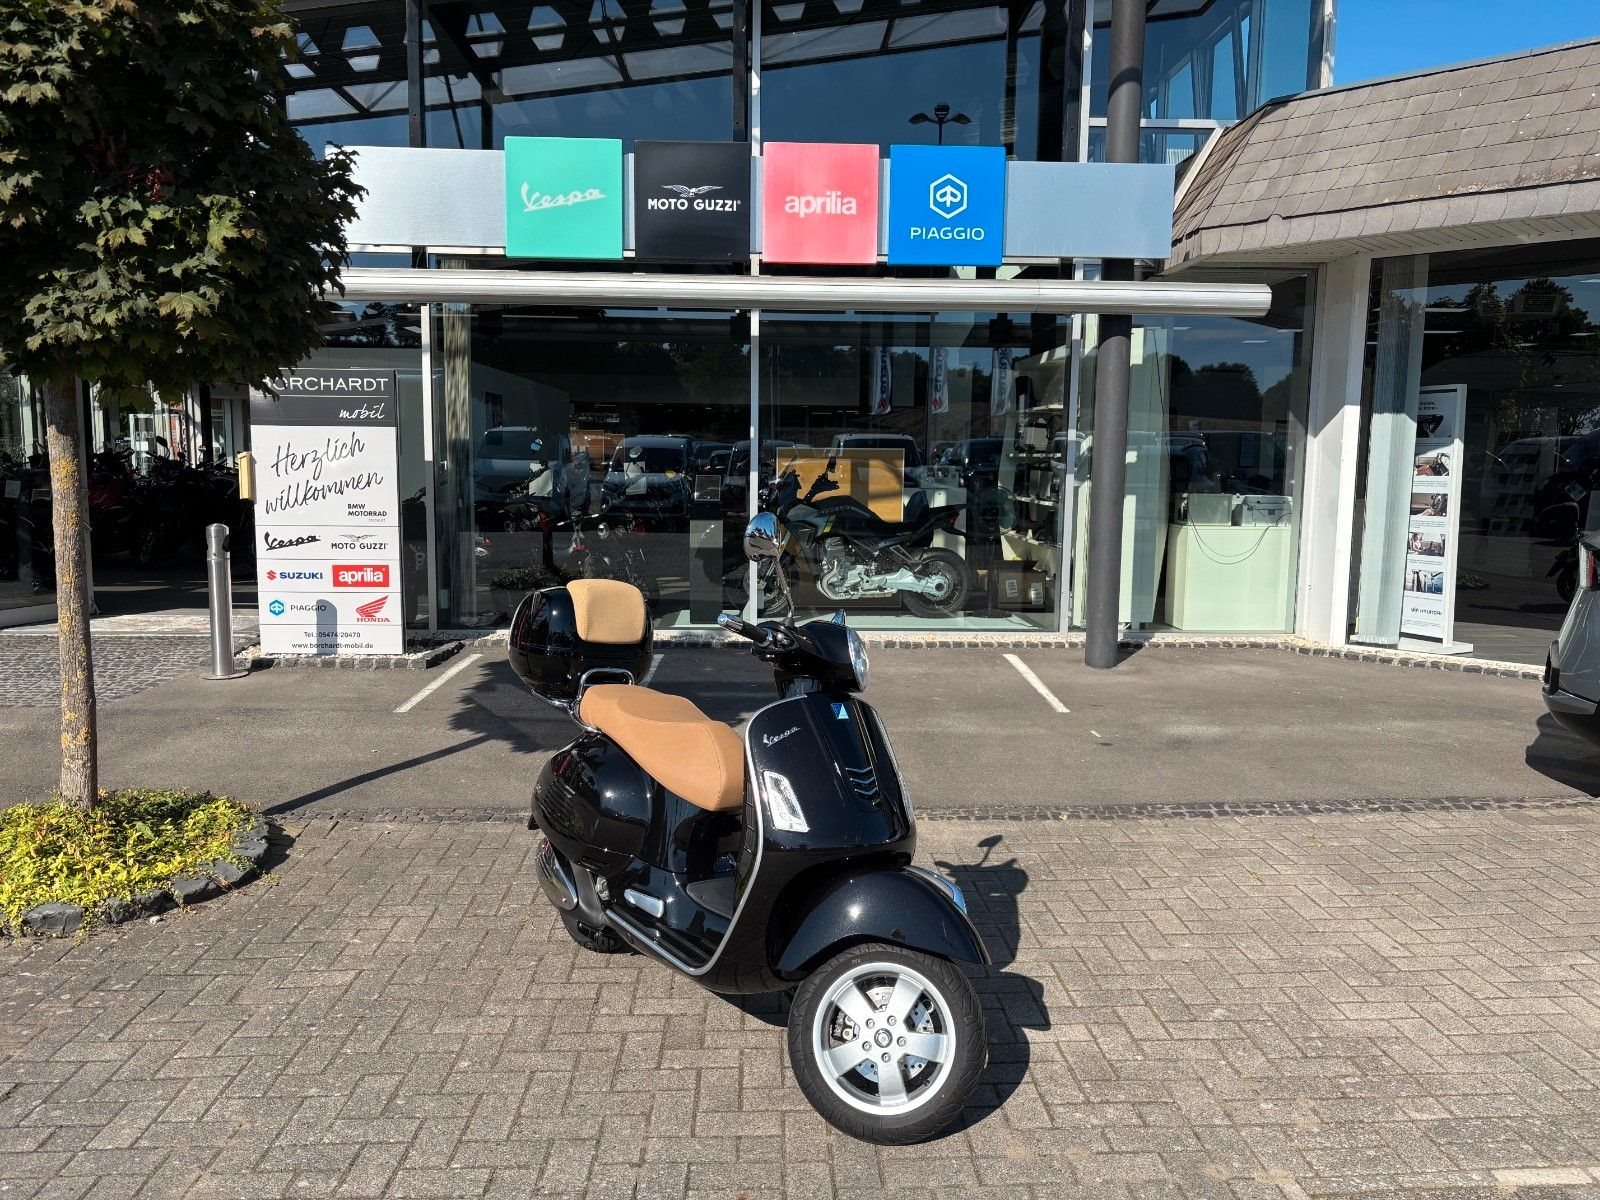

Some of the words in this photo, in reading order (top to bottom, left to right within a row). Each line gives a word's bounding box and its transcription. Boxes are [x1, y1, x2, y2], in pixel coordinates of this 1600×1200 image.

[521, 181, 607, 213] Vespa
[647, 198, 688, 211] MOTO
[693, 198, 738, 212] GUZZI
[784, 191, 857, 218] aprilia
[910, 227, 985, 241] PIAGGIO
[262, 376, 388, 391] ORCHARDT
[339, 403, 385, 419] mobil
[271, 431, 365, 481] Herzlich
[265, 472, 384, 515] willkommen
[264, 531, 322, 551] Vespa
[331, 542, 356, 550] MOTO
[359, 542, 387, 550] GUZZI
[279, 571, 324, 580] SUZUKI
[338, 568, 384, 584] aprilia
[290, 604, 327, 612] PIAGGIO
[763, 726, 801, 748] Vespa
